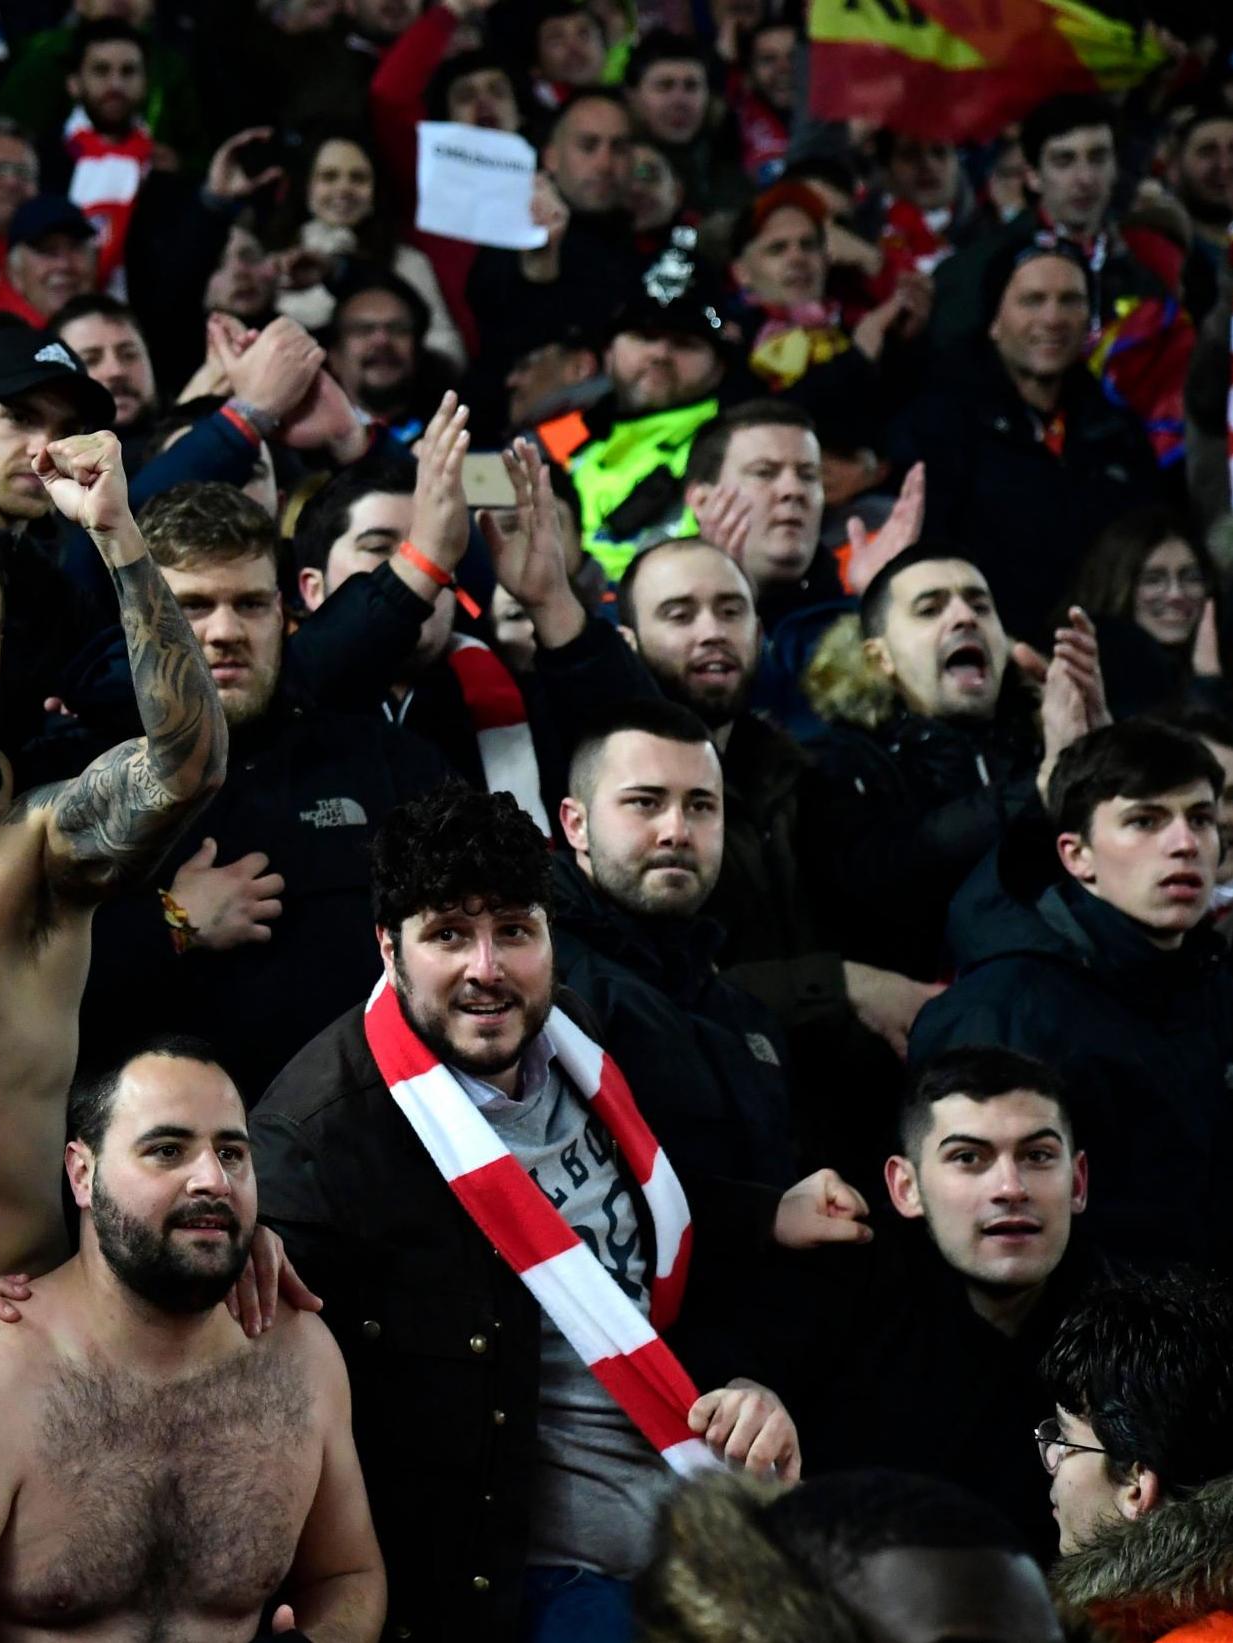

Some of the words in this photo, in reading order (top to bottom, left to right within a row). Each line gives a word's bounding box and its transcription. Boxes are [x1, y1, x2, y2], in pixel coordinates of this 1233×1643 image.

[299, 809, 345, 822] NORTH
[314, 817, 345, 829] FACE
[528, 1114, 609, 1209] LBO
